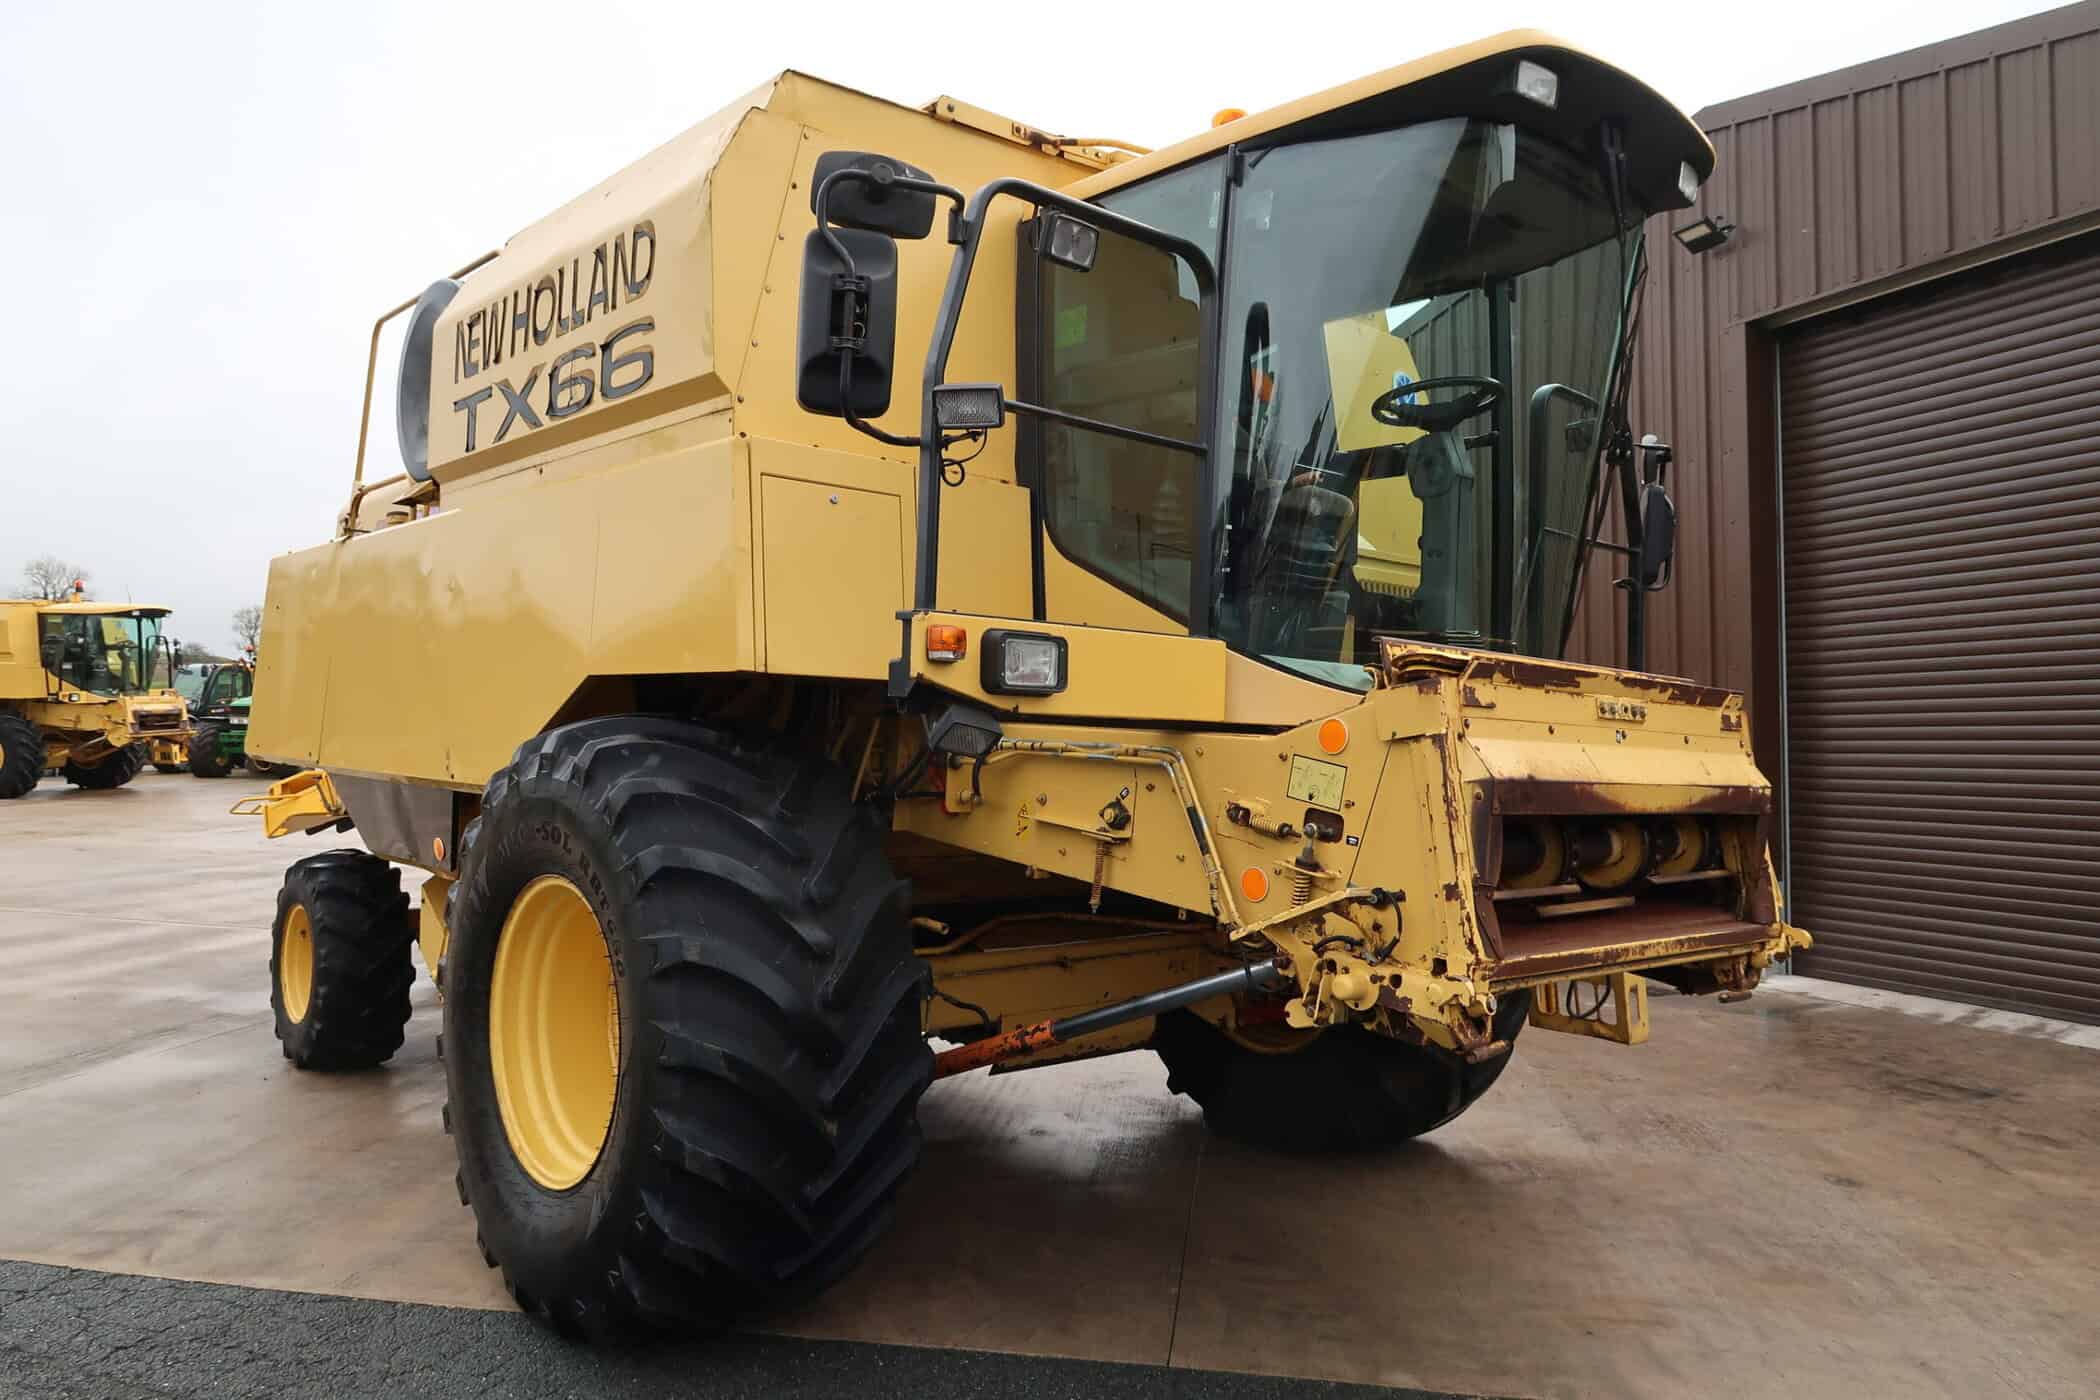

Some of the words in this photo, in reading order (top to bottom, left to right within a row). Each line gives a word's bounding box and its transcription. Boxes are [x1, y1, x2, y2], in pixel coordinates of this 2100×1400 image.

[454, 296, 508, 385] NEW
[510, 218, 657, 358] HOLLAND
[452, 315, 656, 453] TX66
